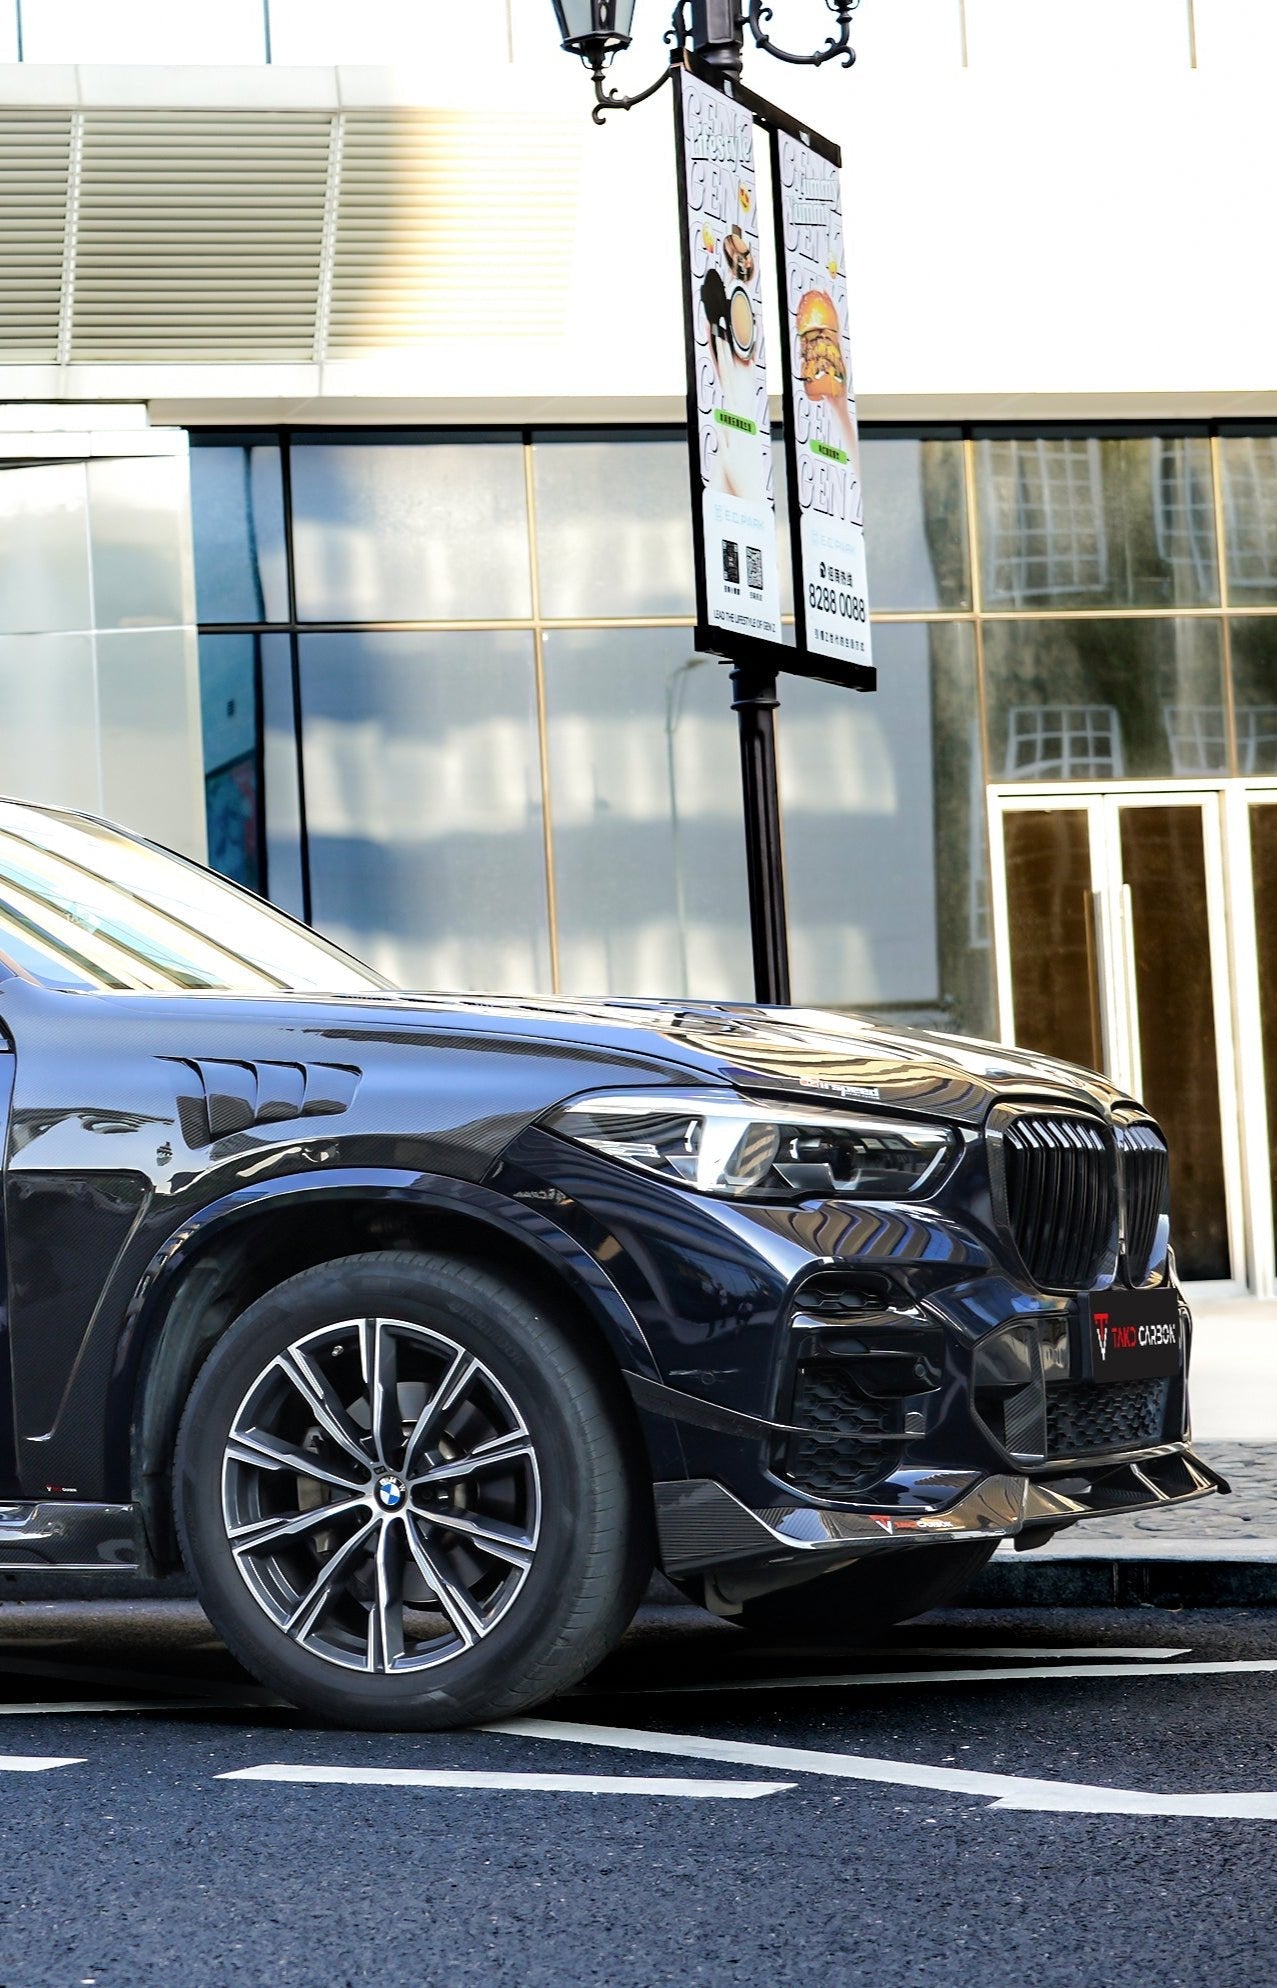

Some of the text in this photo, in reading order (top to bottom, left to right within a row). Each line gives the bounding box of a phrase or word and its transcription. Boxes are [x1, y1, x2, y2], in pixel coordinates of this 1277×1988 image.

[809, 583, 866, 623] 8288 0088
[725, 612, 735, 623] THE
[1138, 1323, 1176, 1347] CARBON
[379, 1476, 406, 1492] BMW
